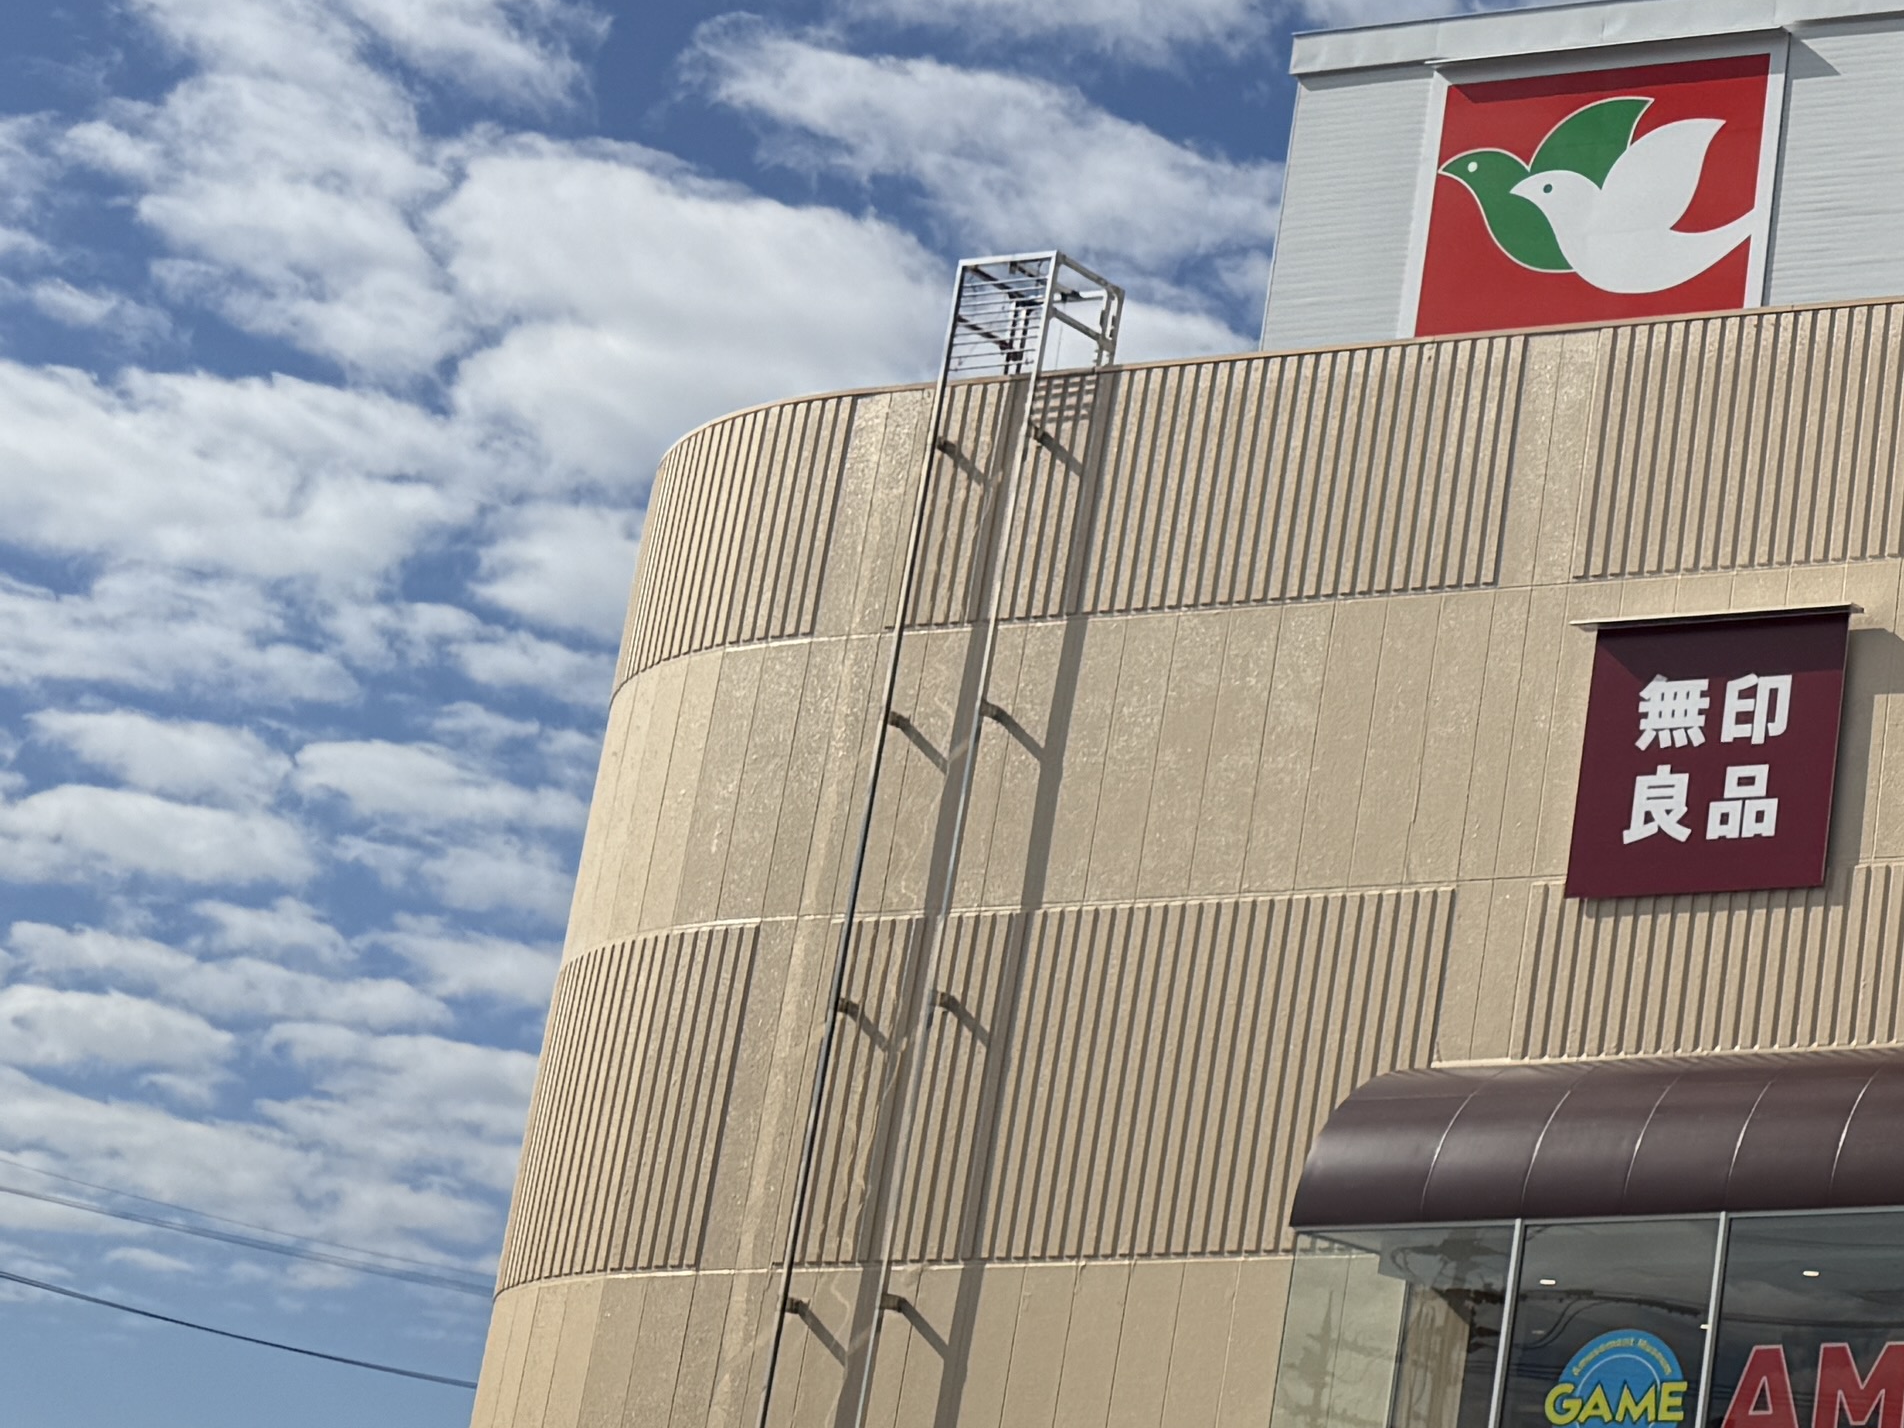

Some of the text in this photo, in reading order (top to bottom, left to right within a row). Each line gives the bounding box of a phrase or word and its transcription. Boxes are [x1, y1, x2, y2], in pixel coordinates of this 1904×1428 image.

[1635, 673, 1793, 750] 無印
[1621, 763, 1779, 846] 良品
[1545, 1381, 1688, 1426] GAME
